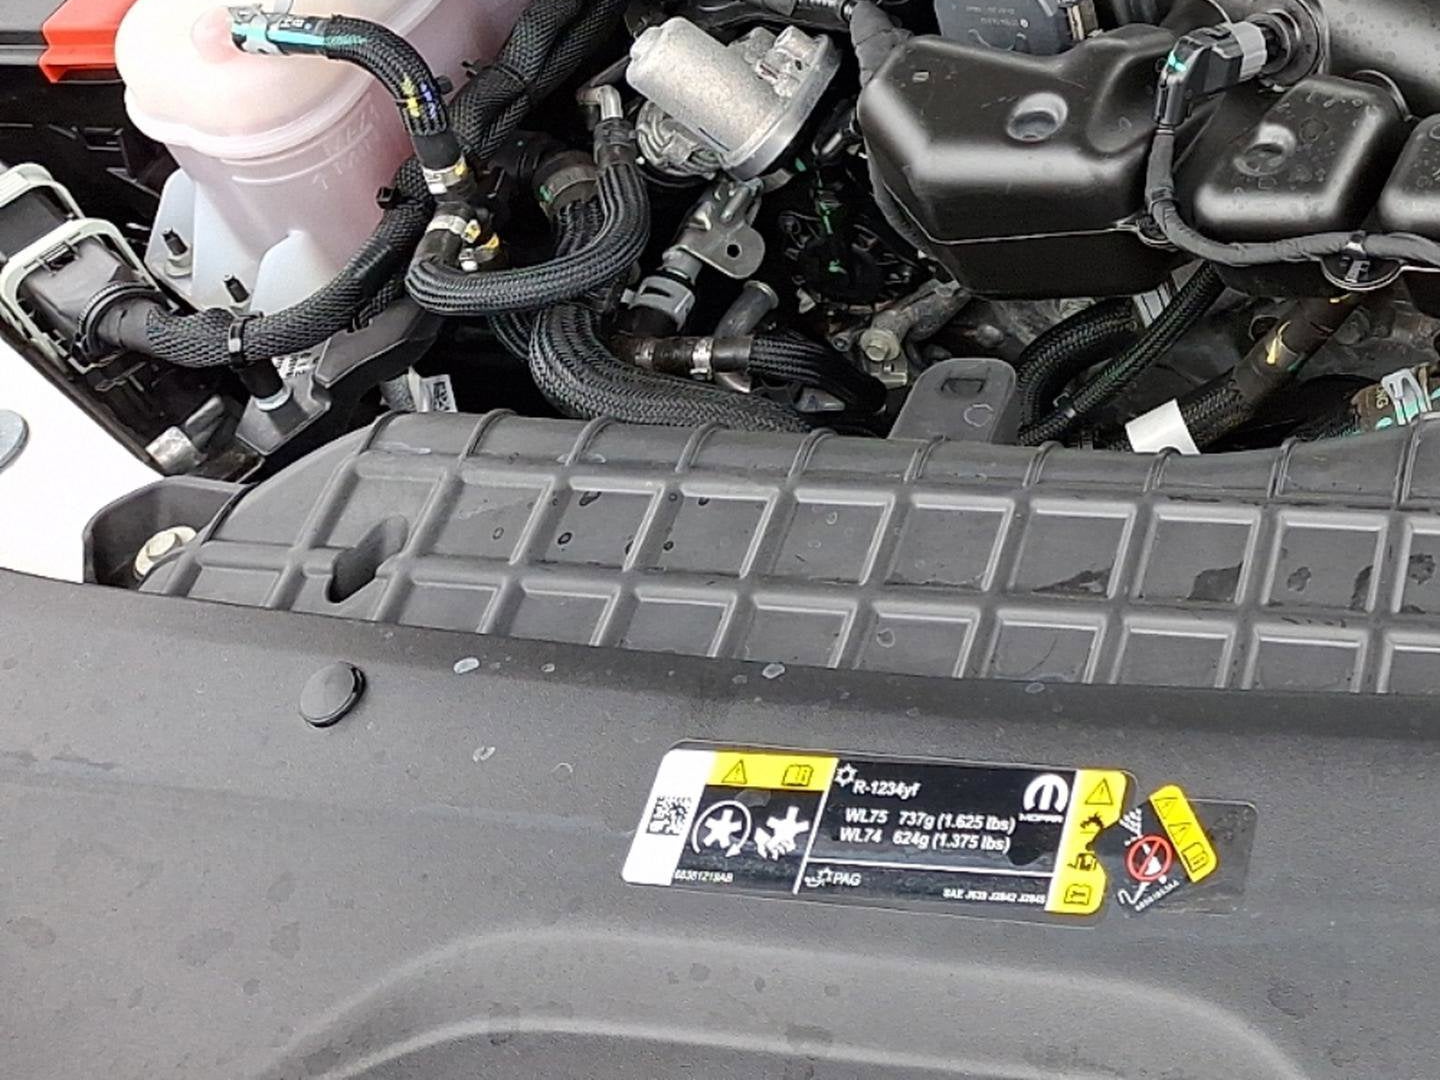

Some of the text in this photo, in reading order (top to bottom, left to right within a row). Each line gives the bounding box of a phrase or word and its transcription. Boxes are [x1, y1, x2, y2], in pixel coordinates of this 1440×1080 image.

[852, 779, 921, 800] R-1234yf
[845, 808, 1016, 835] WL75 737g (1.625 lbs)
[840, 826, 1011, 854] WL74 624g (1.375 lbs)
[832, 872, 861, 887] PAG
